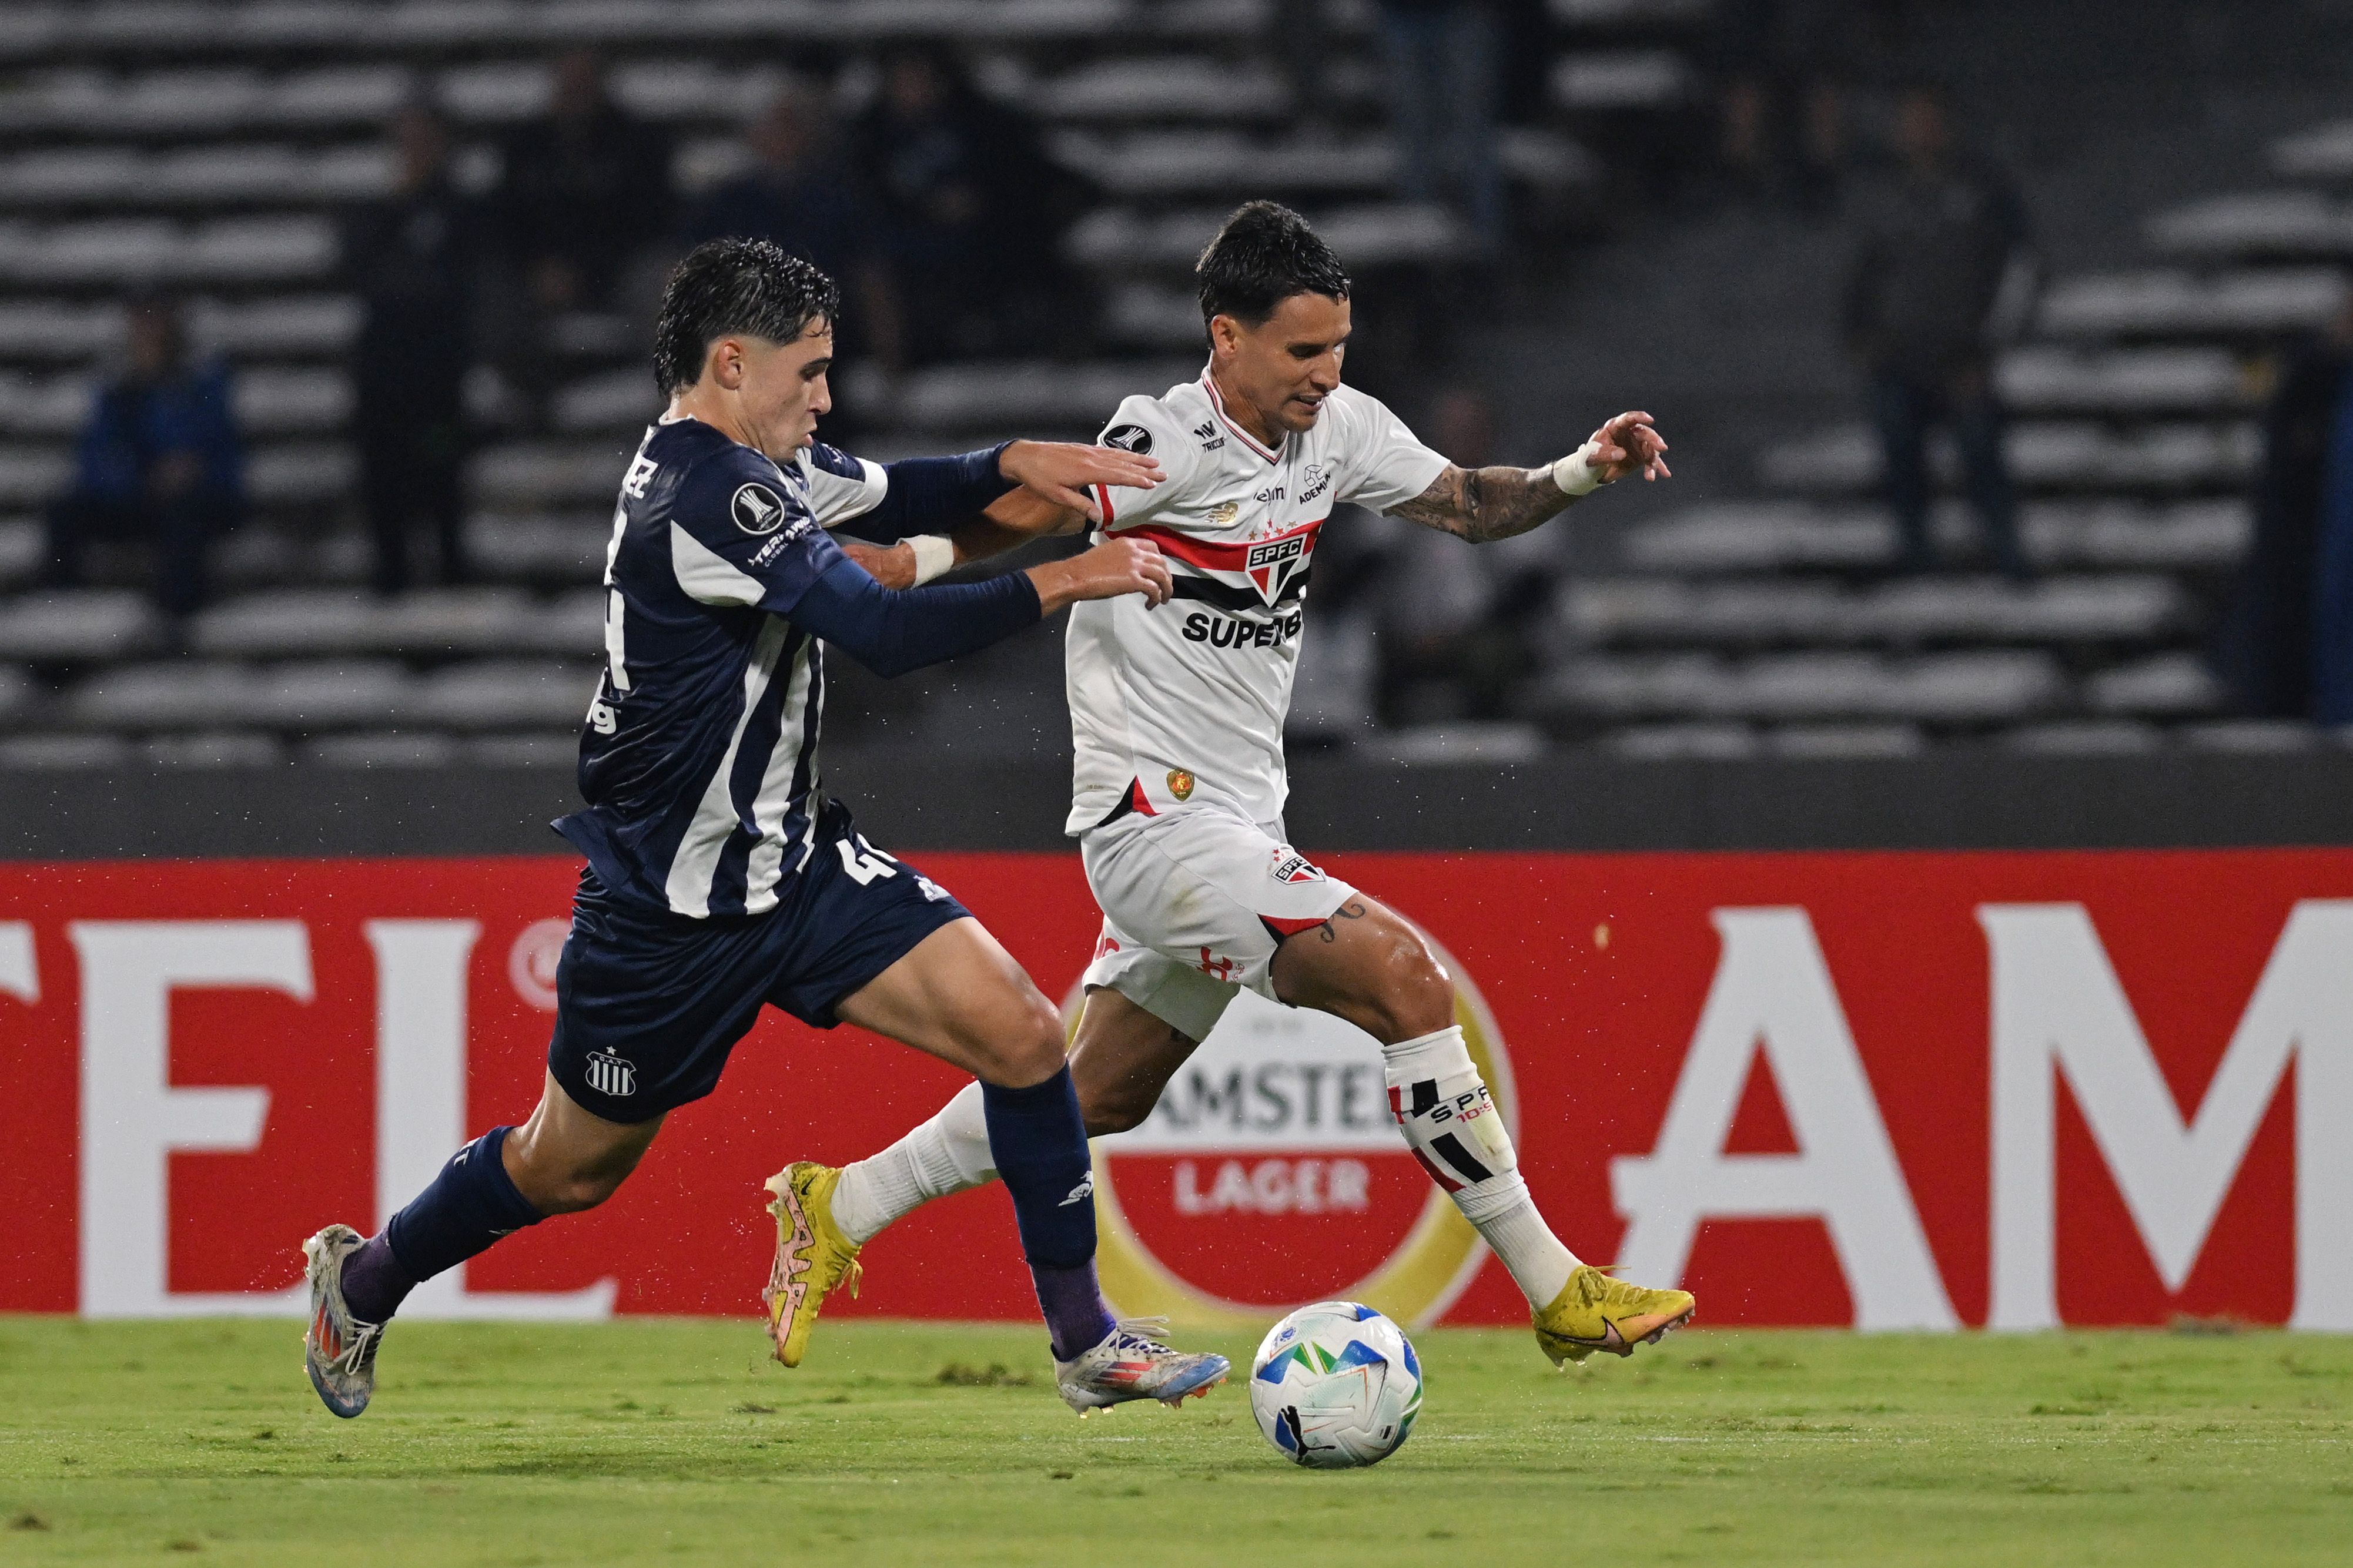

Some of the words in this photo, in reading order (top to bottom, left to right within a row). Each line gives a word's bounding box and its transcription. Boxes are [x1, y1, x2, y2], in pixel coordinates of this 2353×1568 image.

[1252, 540, 1300, 564] SPFC
[836, 833, 899, 886] 4
[1277, 857, 1307, 880] SPFC
[0, 919, 617, 1320] EL
[1608, 899, 2353, 1333] AM
[1174, 1158, 1371, 1214] LAGER
